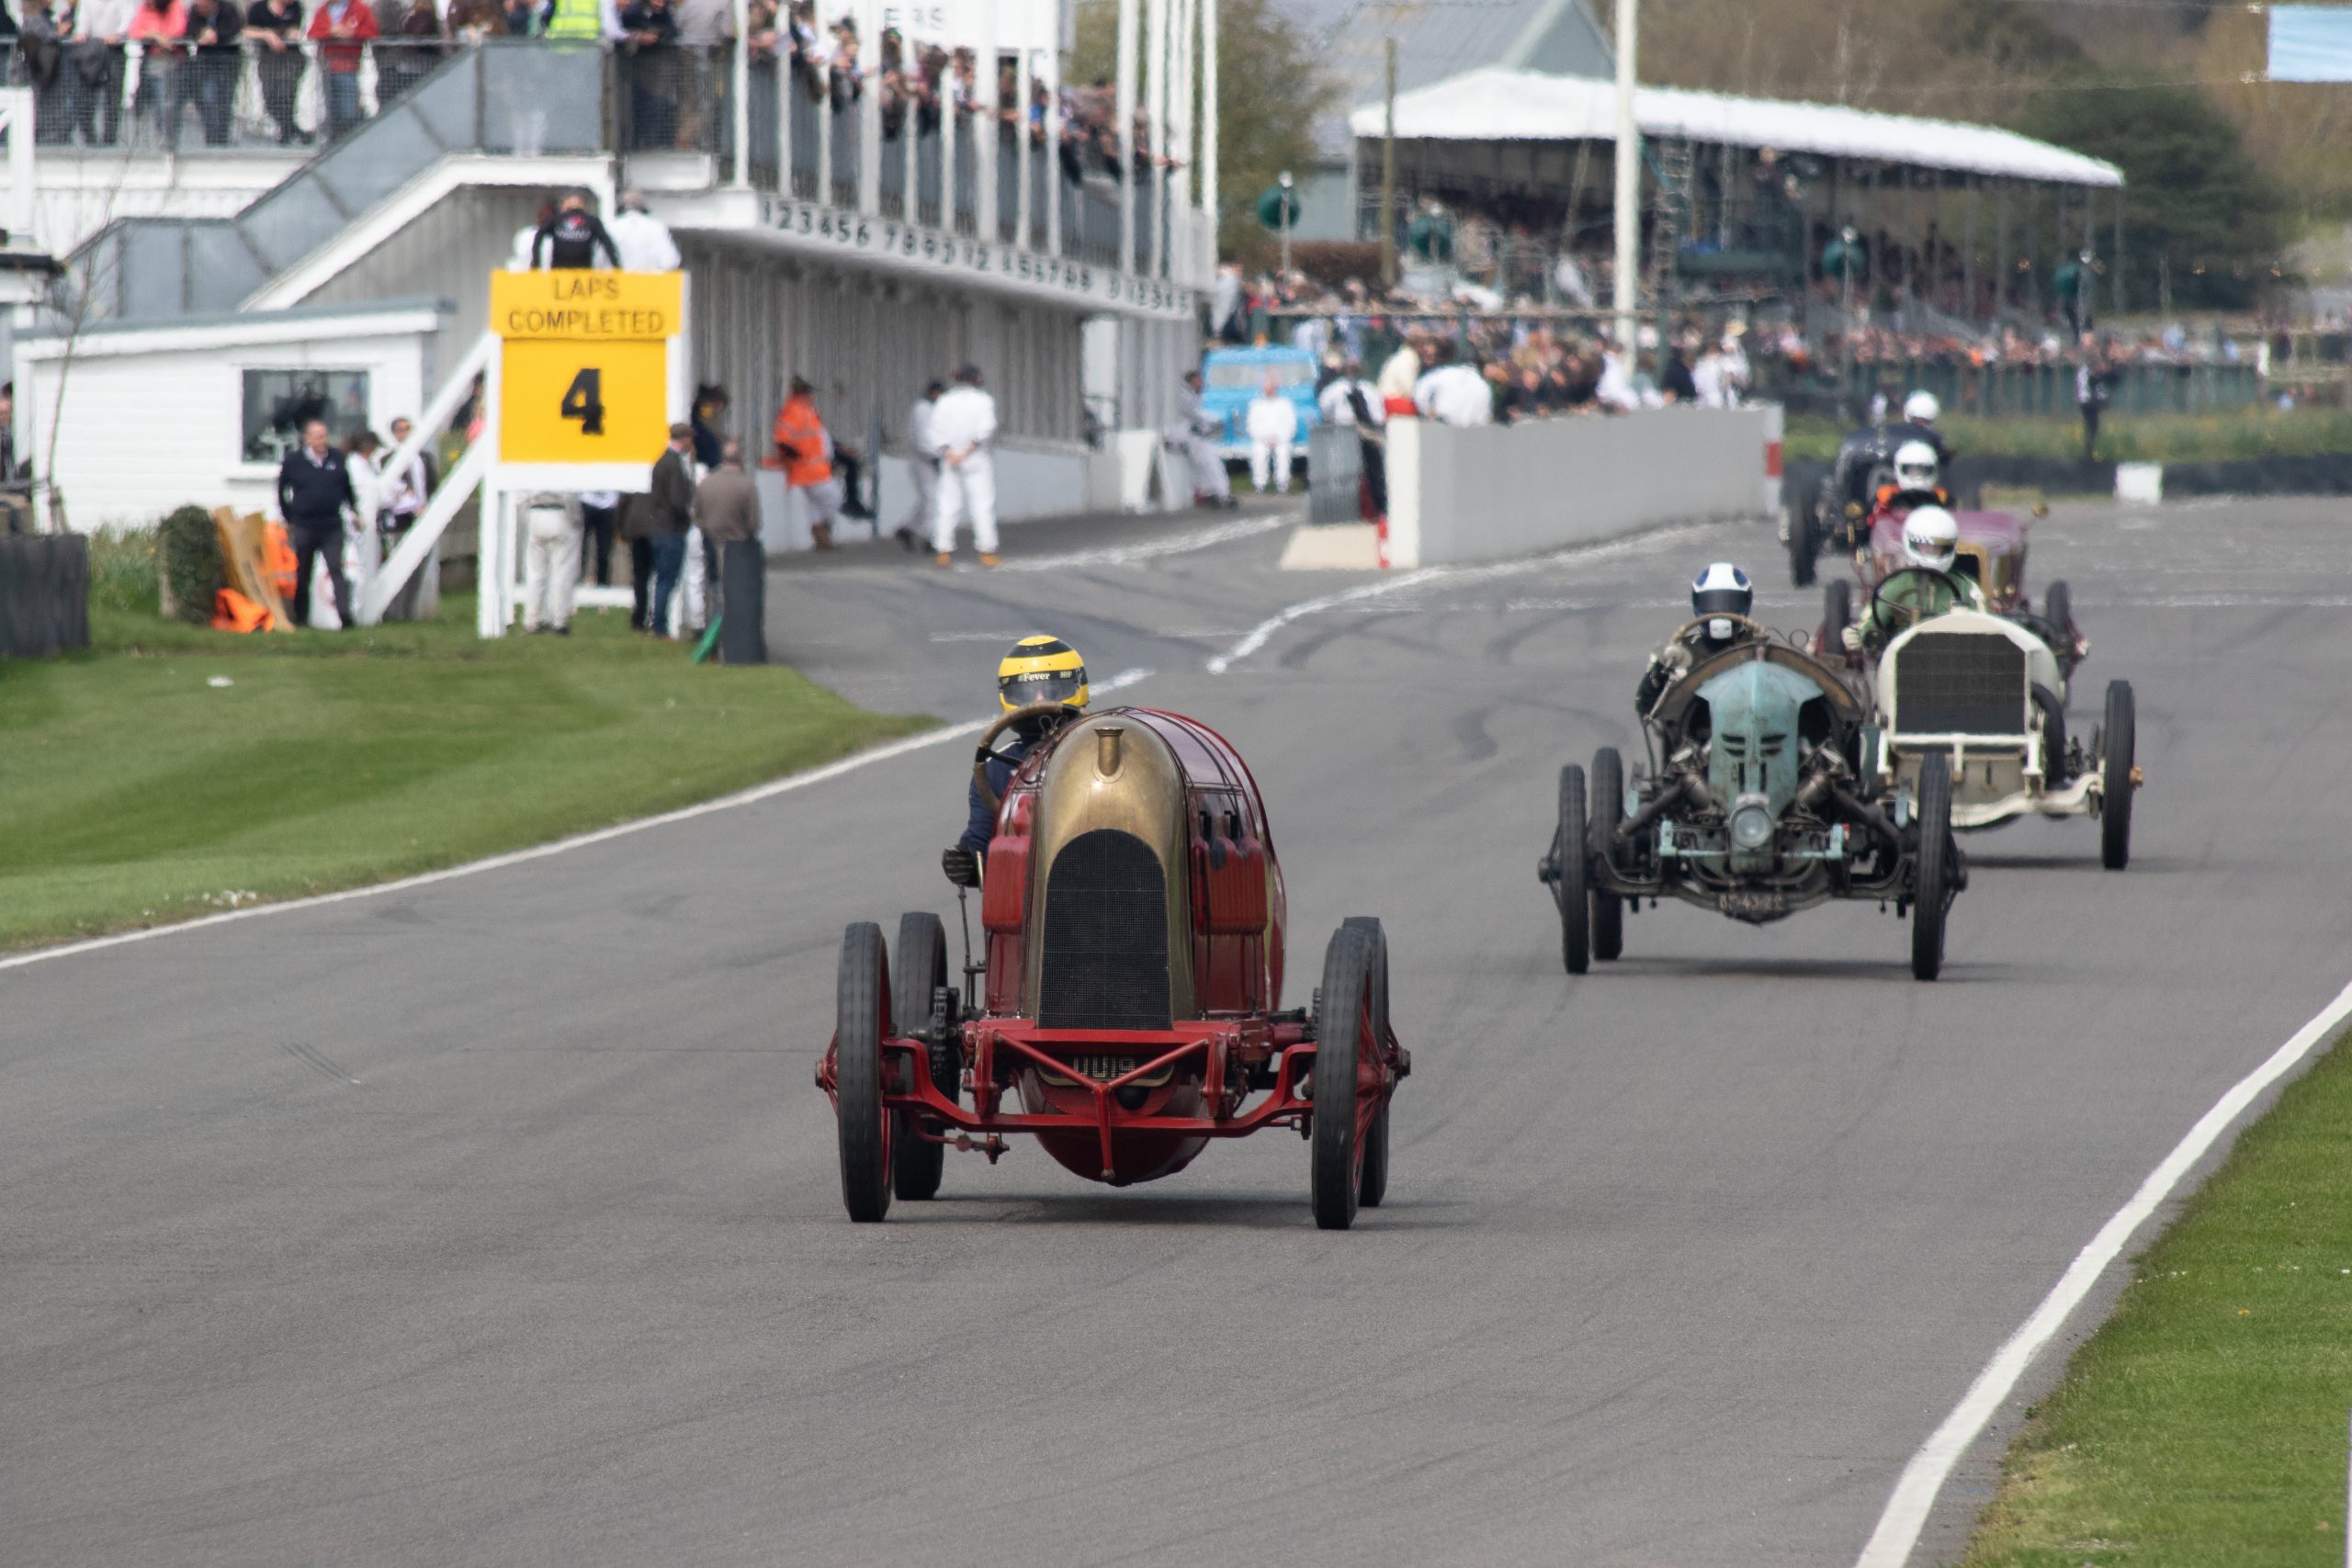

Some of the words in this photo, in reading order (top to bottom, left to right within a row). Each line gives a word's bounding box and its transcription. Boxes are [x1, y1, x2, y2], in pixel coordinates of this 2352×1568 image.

[778, 205, 794, 230] 2
[799, 210, 812, 234] 3
[820, 216, 832, 238] 4
[838, 219, 852, 243] 5
[856, 224, 871, 247] 6
[902, 232, 917, 257] 8
[553, 278, 619, 300] LAPS
[509, 310, 663, 333] COMPLETED
[560, 367, 605, 436] 4
